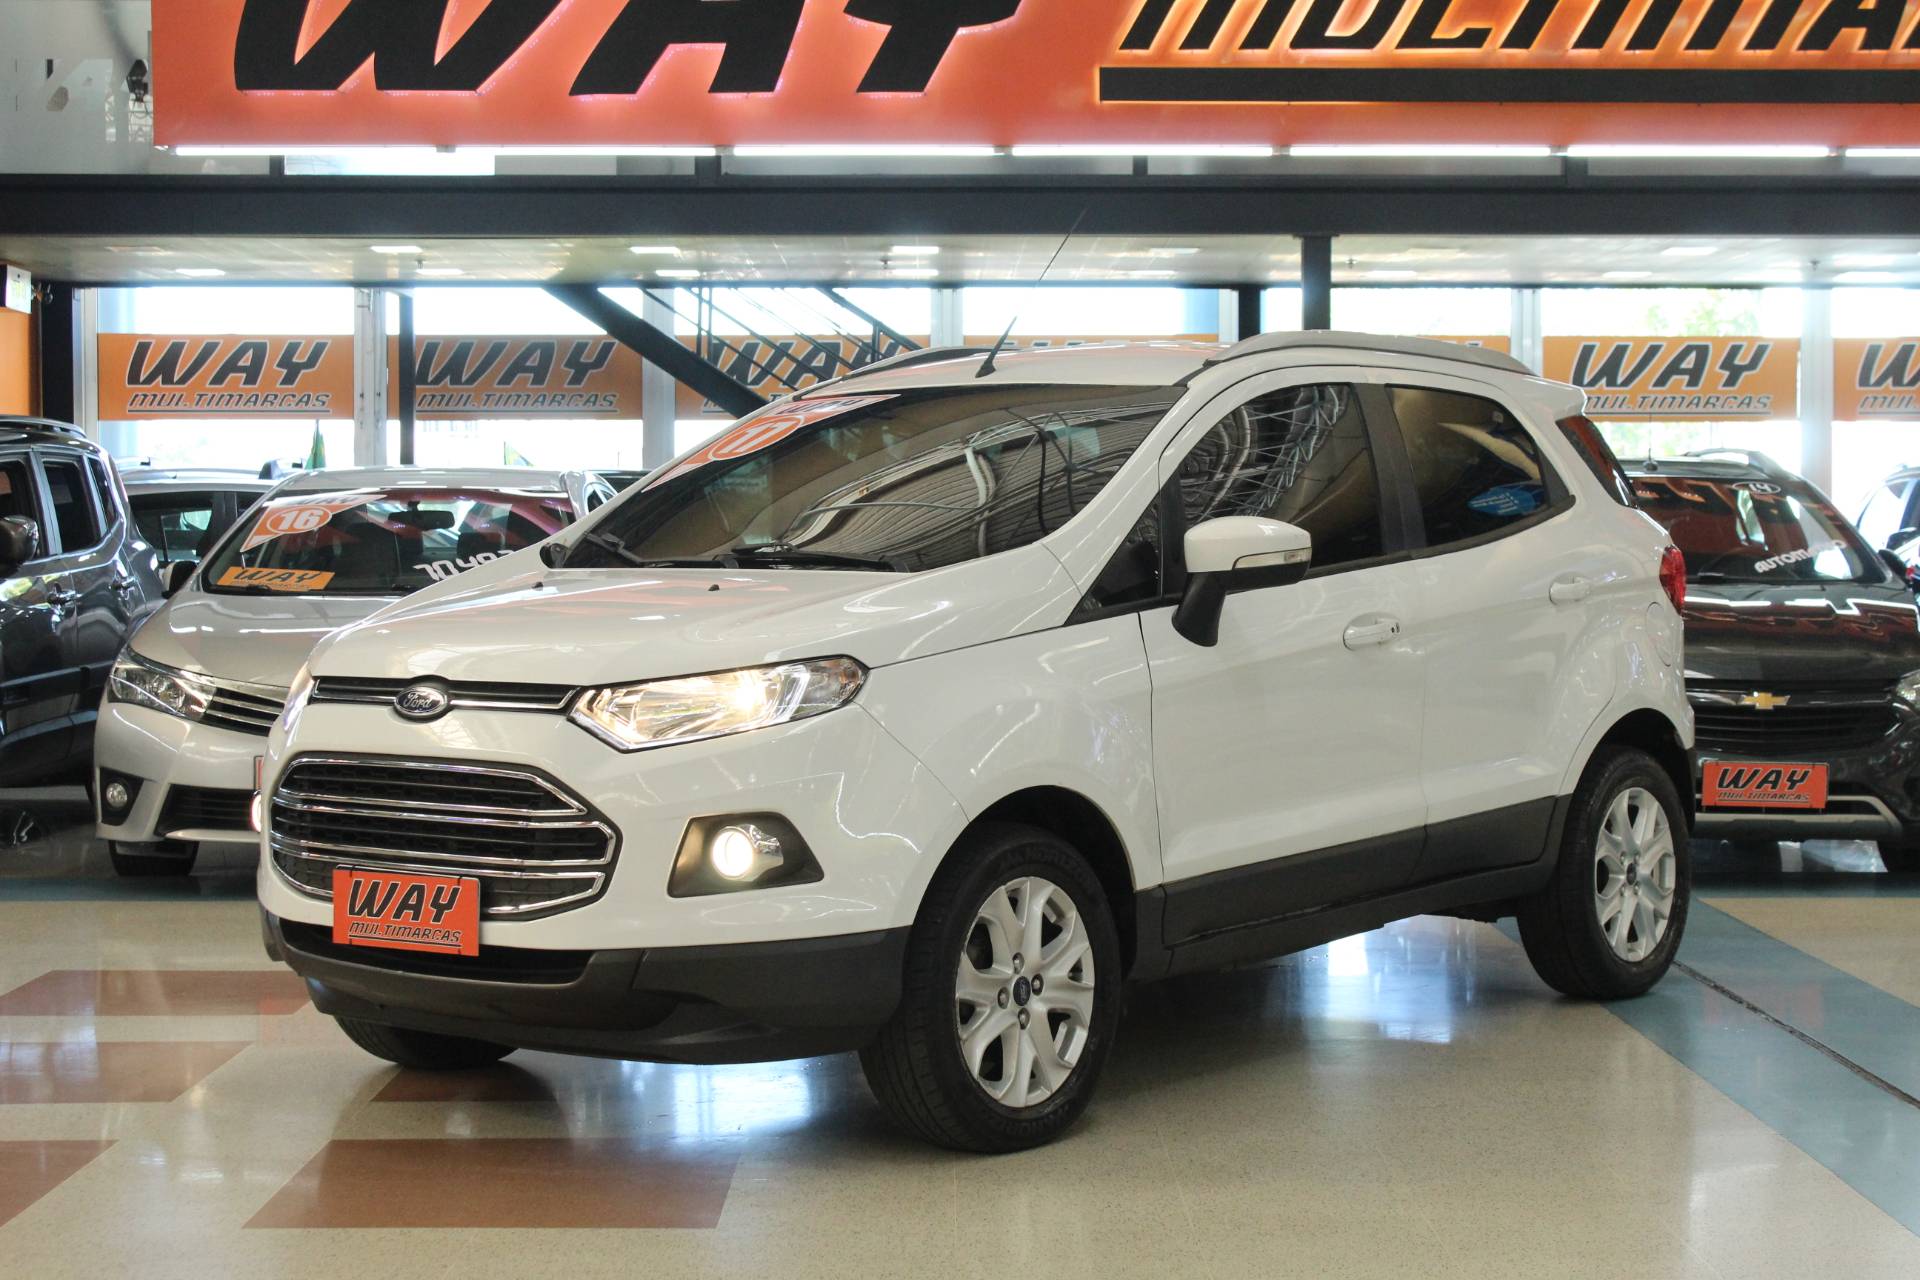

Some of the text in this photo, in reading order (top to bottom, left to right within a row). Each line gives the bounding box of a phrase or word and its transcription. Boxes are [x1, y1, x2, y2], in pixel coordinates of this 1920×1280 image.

[126, 340, 331, 388] WAY
[416, 340, 618, 388] WAY
[1571, 342, 1775, 390] WAY
[128, 392, 331, 408] MULTIMARCAS
[416, 392, 618, 409] MULTIMARCAS
[1586, 394, 1773, 411] MULTIMARCAS
[278, 509, 325, 531] 16
[232, 568, 322, 583] WAY
[403, 691, 433, 709] Ford
[1716, 767, 1812, 791] WAY
[348, 878, 462, 925] WAY
[349, 921, 462, 944] MULTIMARCAS
